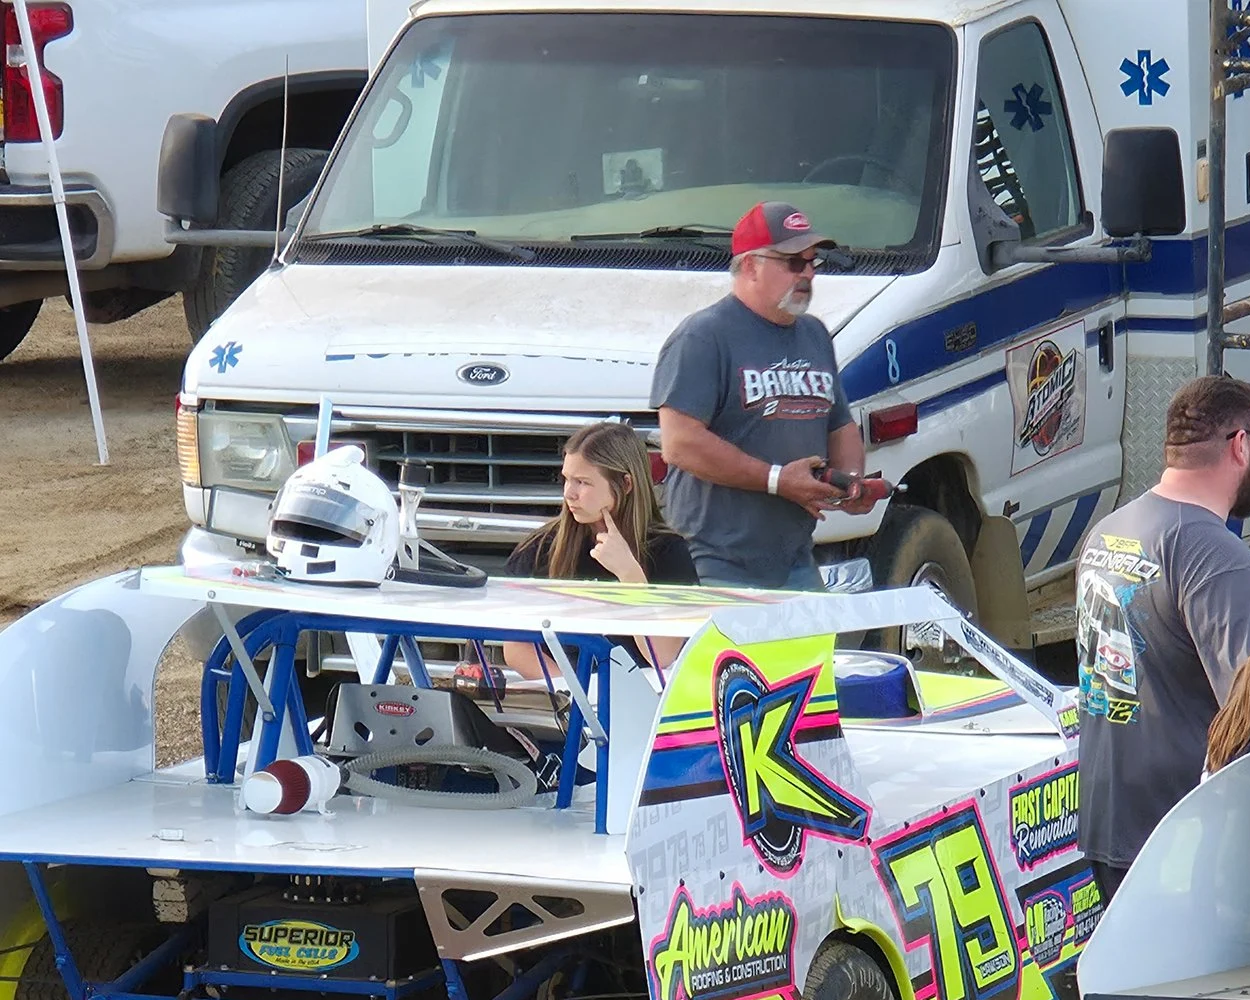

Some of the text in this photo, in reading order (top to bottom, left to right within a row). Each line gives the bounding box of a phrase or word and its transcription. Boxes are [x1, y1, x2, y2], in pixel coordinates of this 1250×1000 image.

[885, 338, 900, 384] 8
[742, 369, 836, 405] BARKER
[1023, 352, 1076, 431] ATOMIC
[762, 399, 780, 417] 2
[1081, 547, 1161, 580] CONRAD
[736, 692, 858, 828] K
[1012, 786, 1041, 836] FIRST
[244, 925, 355, 948] SUPERIOR
[691, 953, 789, 992] ROOFING & CONSTRUCTION
